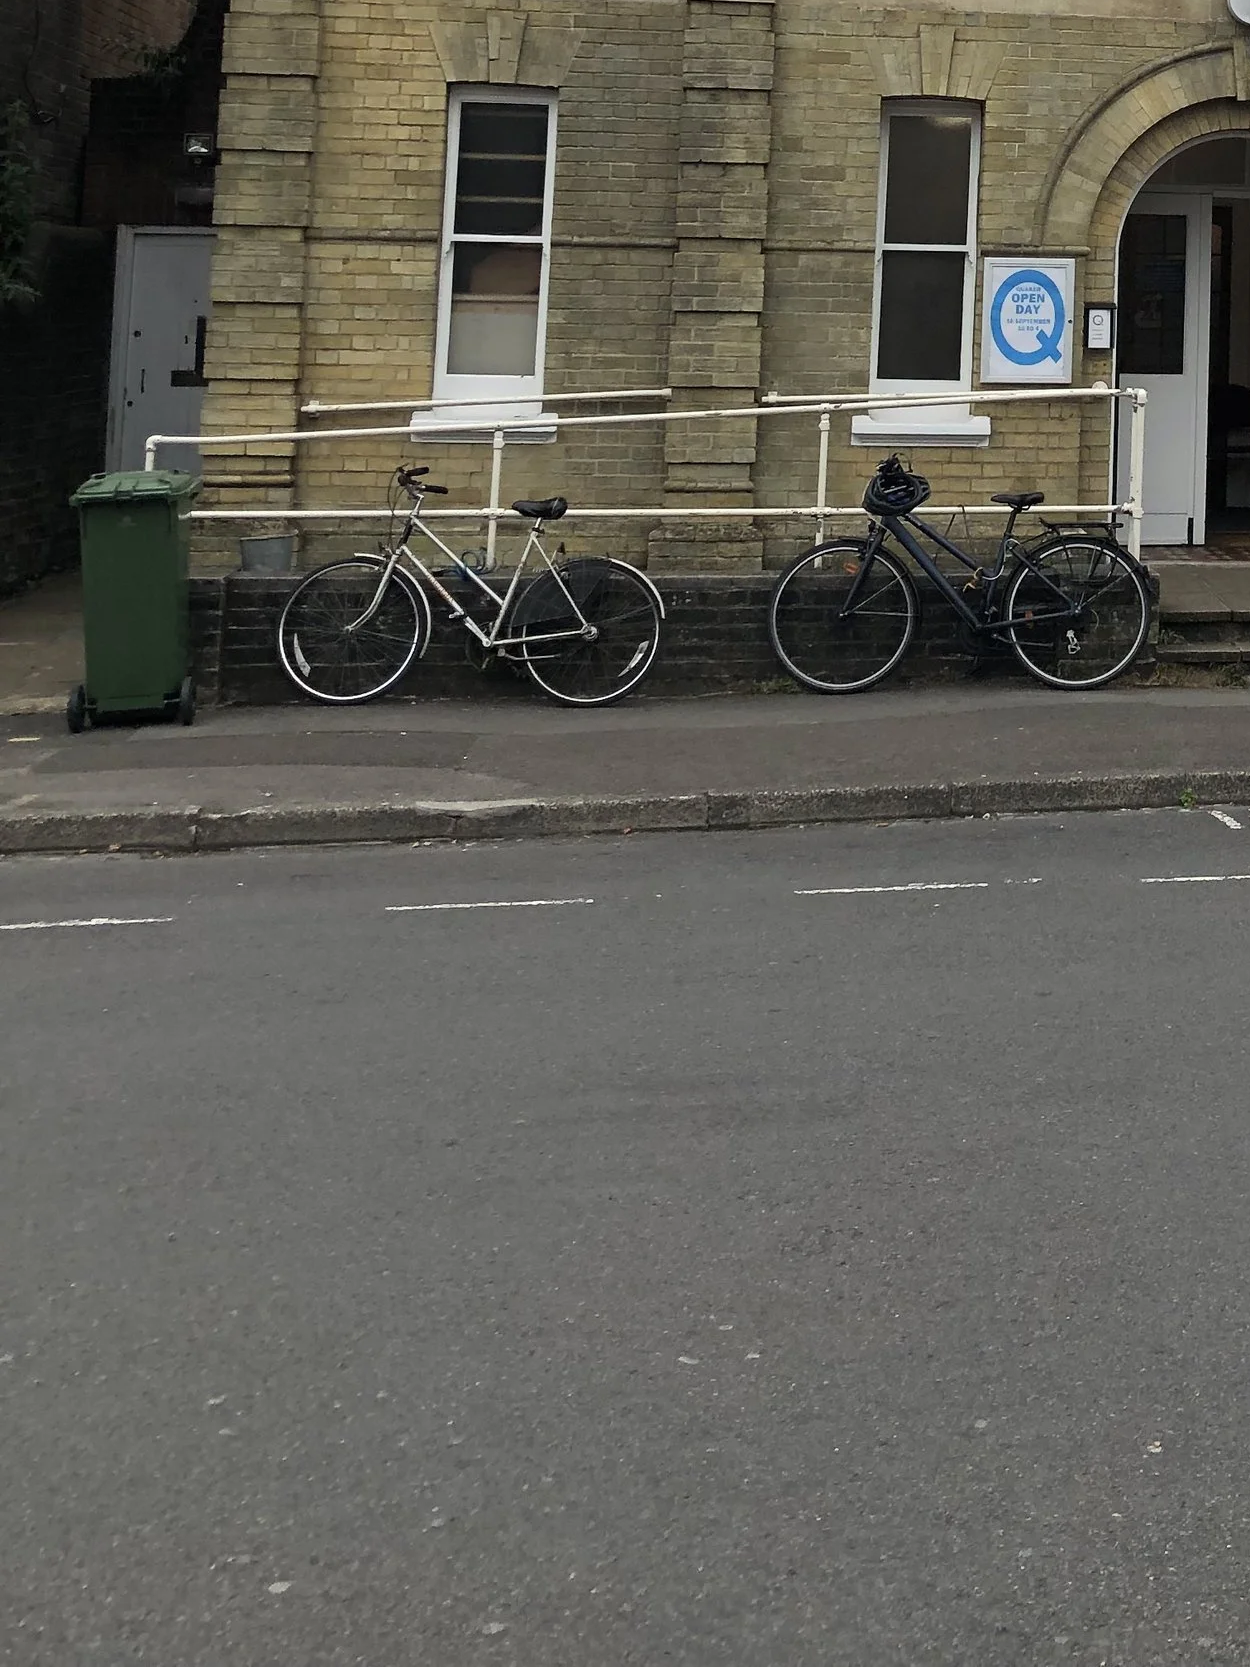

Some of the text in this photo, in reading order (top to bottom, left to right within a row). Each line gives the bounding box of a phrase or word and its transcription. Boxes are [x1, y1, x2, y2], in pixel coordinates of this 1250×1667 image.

[1011, 293, 1045, 303] OPEN
[1015, 305, 1041, 315] DAY
[990, 269, 1065, 366] Q
